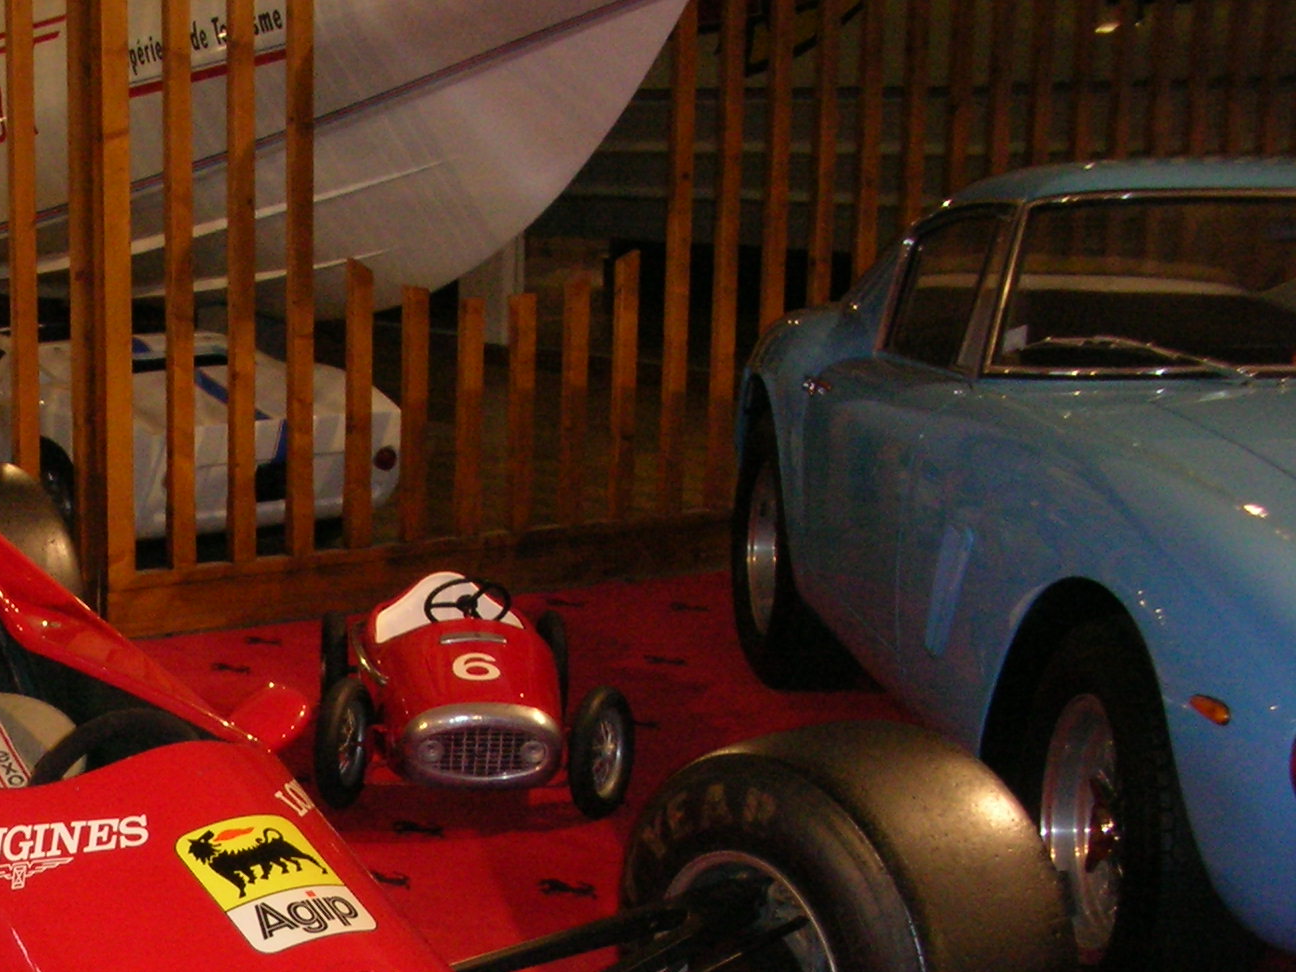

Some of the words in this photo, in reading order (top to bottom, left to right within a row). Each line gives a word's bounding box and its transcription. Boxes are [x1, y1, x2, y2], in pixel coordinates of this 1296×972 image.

[190, 21, 209, 51] de
[452, 652, 501, 681] 6
[255, 889, 359, 940] Agip
